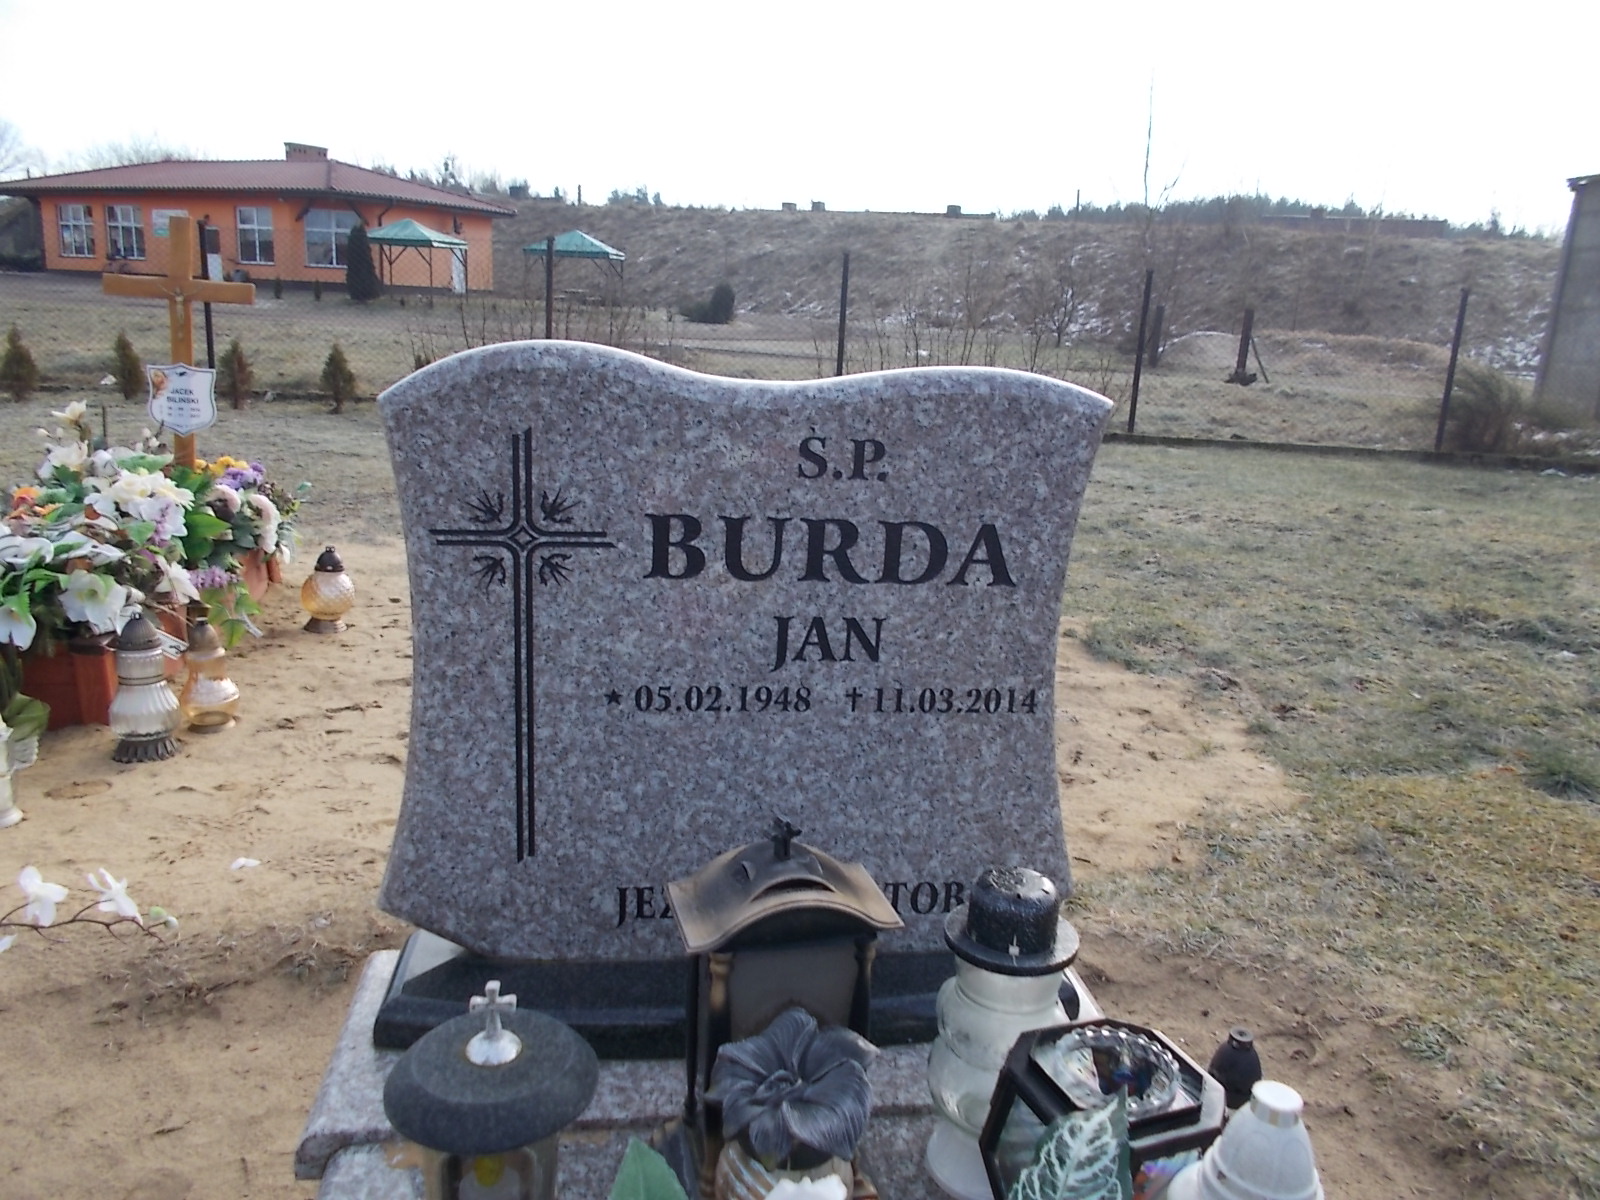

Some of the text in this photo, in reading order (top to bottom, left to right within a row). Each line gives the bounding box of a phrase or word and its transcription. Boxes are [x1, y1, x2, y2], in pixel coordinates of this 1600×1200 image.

[643, 513, 1018, 588] BURDA
[770, 616, 887, 673] JAN
[634, 684, 1038, 714] 05.02.1948 11.03.2014
